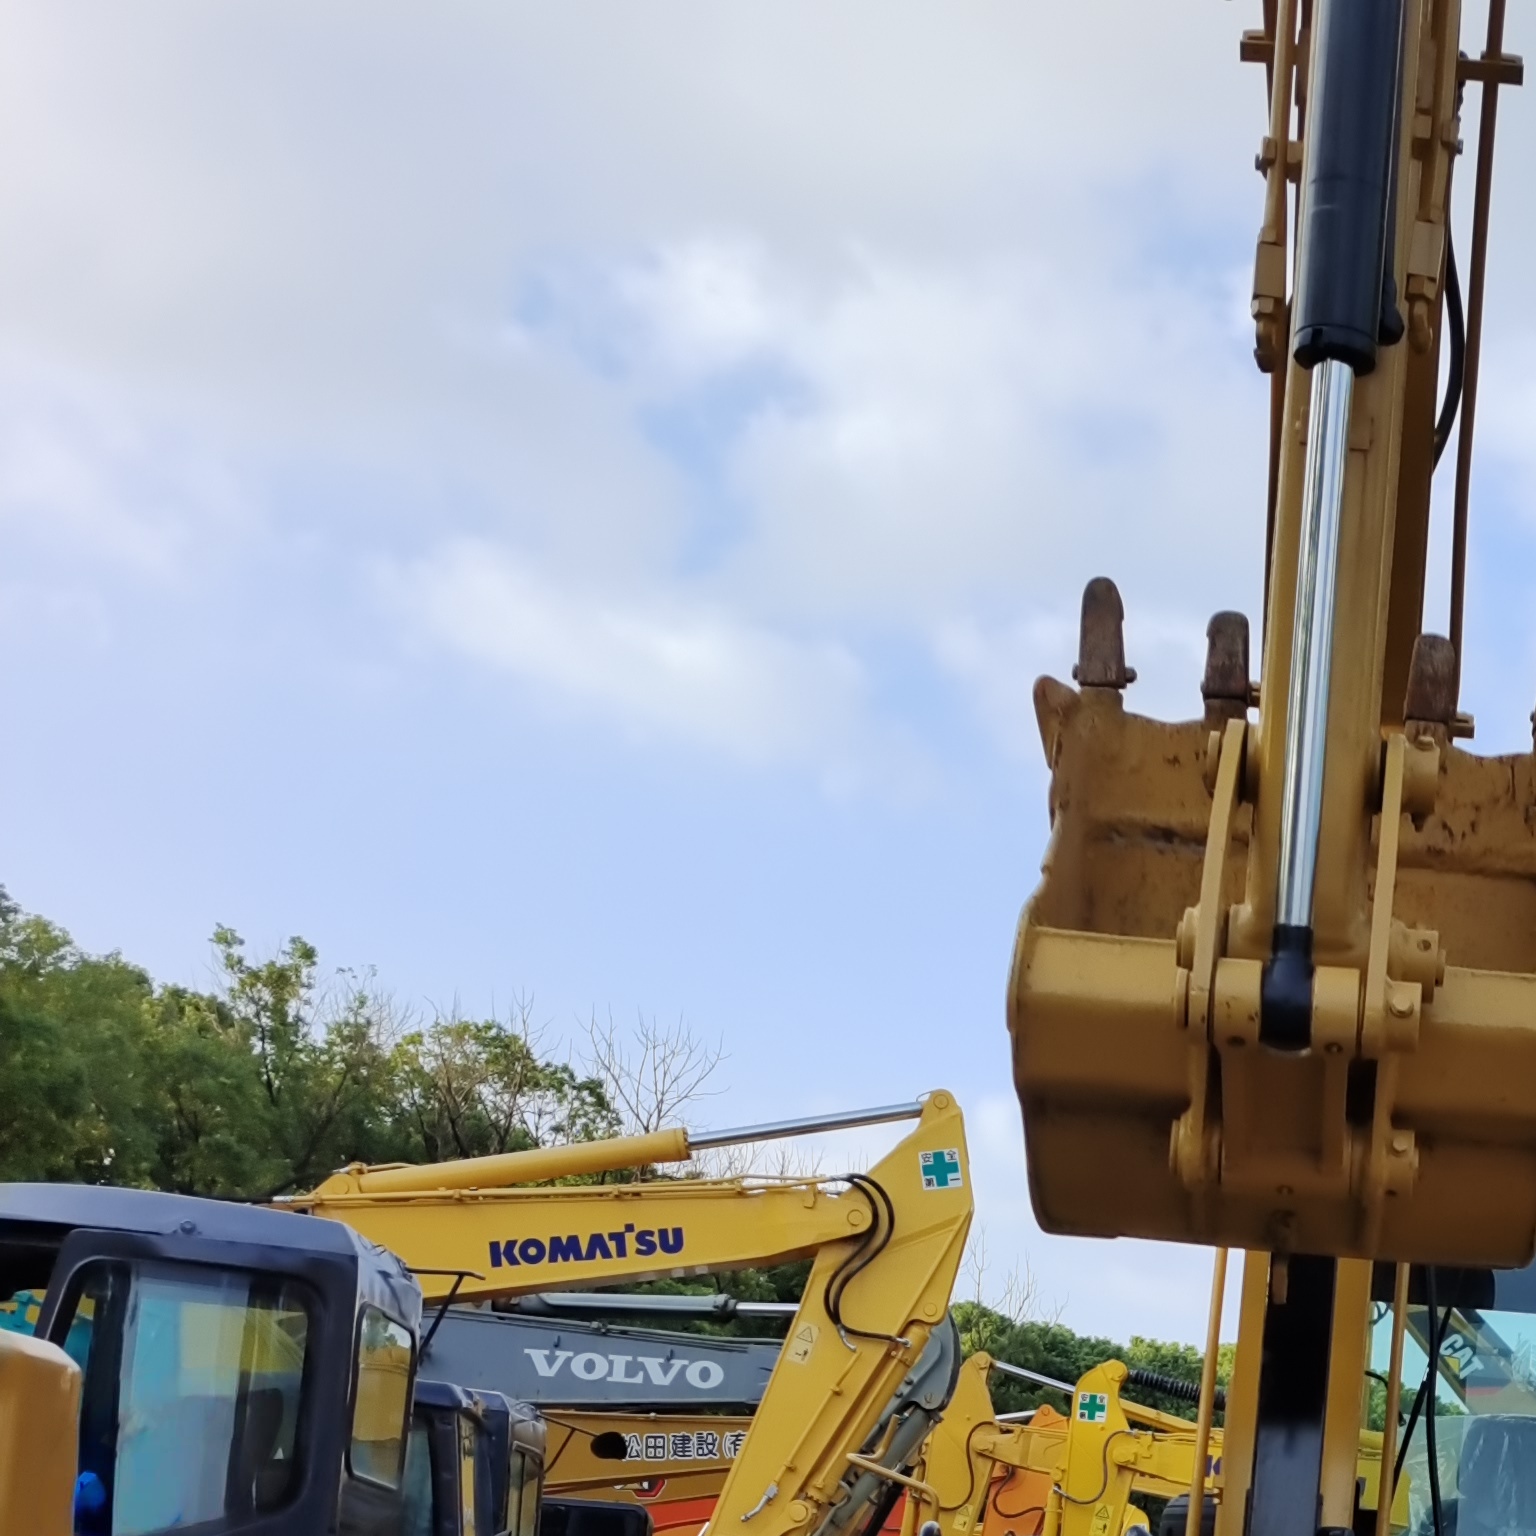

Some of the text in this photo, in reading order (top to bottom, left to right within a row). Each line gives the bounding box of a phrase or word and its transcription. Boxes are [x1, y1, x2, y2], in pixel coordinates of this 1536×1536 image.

[489, 1223, 685, 1268] KOMATSU
[524, 1348, 725, 1389] VOLVO
[1439, 1333, 1485, 1380] CAT
